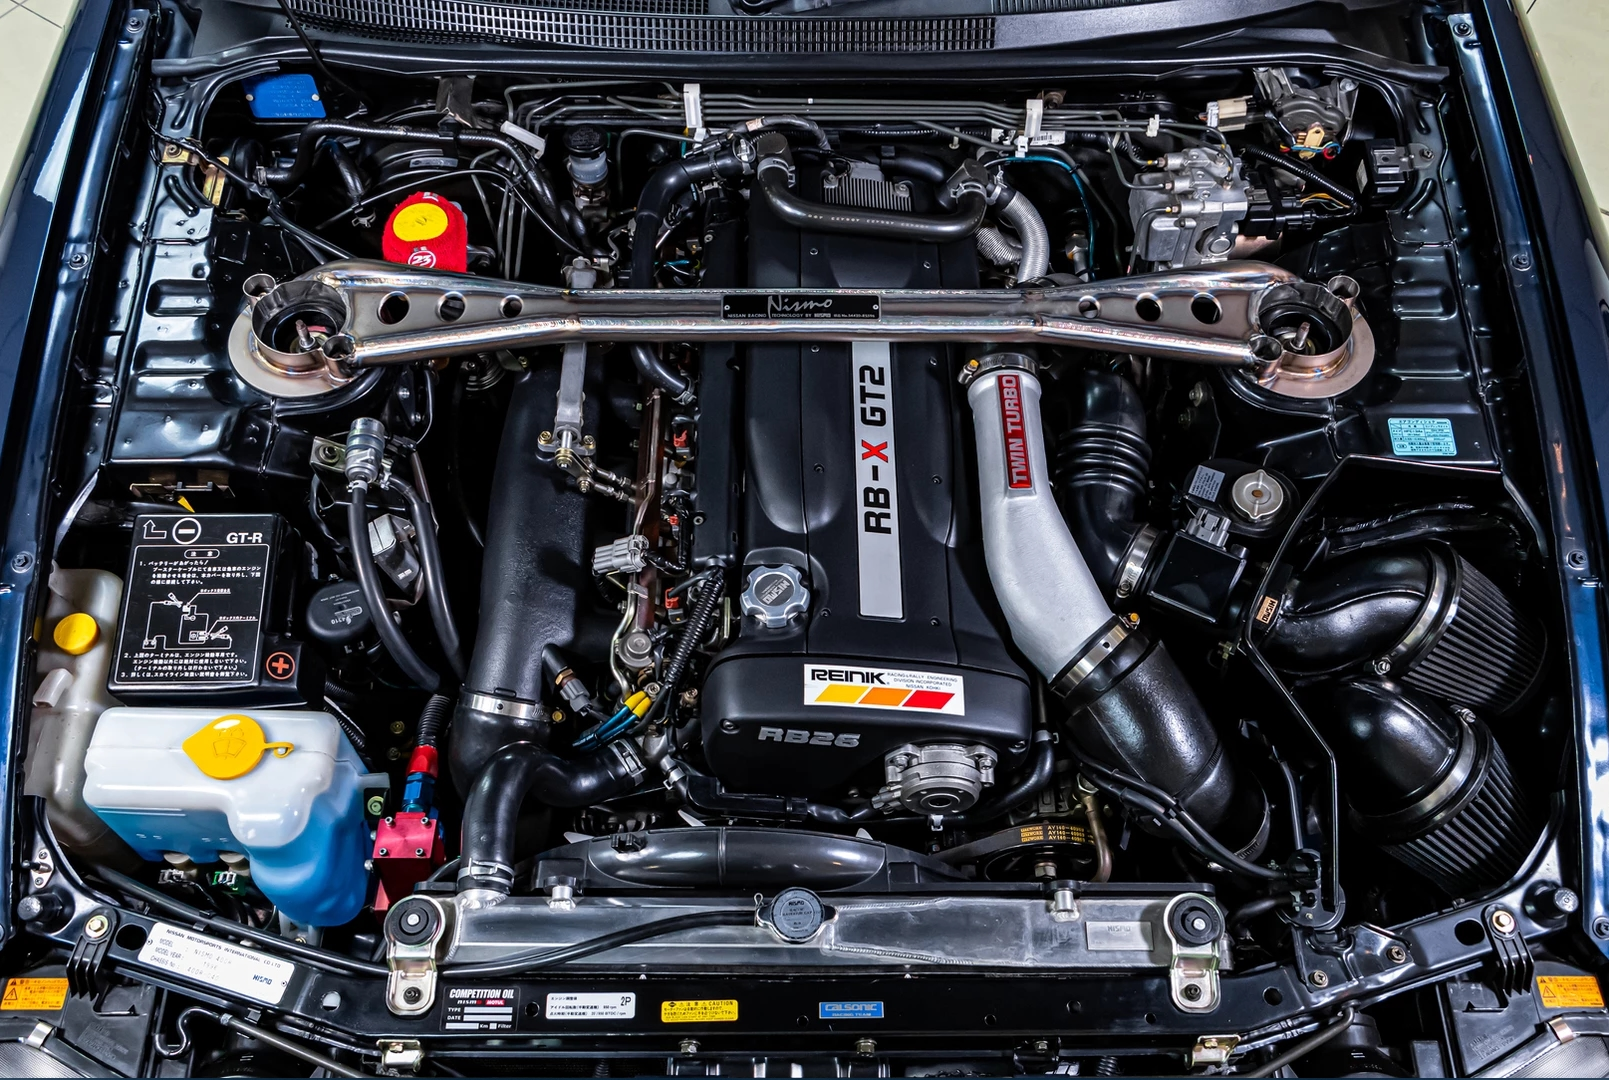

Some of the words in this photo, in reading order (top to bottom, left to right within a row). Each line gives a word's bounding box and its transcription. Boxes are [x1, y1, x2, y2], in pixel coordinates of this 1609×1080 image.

[411, 255, 432, 267] 23
[767, 295, 833, 319] Nismo
[859, 365, 887, 427] GT2
[1002, 375, 1022, 434] TURBO
[1008, 438, 1028, 484] TWIN
[861, 439, 892, 535] RB-X
[226, 532, 263, 544] GT-R
[762, 579, 791, 605] NISMO
[1261, 600, 1276, 622] NISMO
[758, 725, 861, 748] RB26
[166, 929, 185, 939] NISSAN
[186, 934, 222, 950] MOTORSPORTS
[223, 946, 261, 963] INTERNATIONAL
[252, 973, 273, 985] NISMO
[449, 988, 502, 999] COMPETITION
[502, 988, 514, 999] OIL
[620, 996, 632, 1006] 2P
